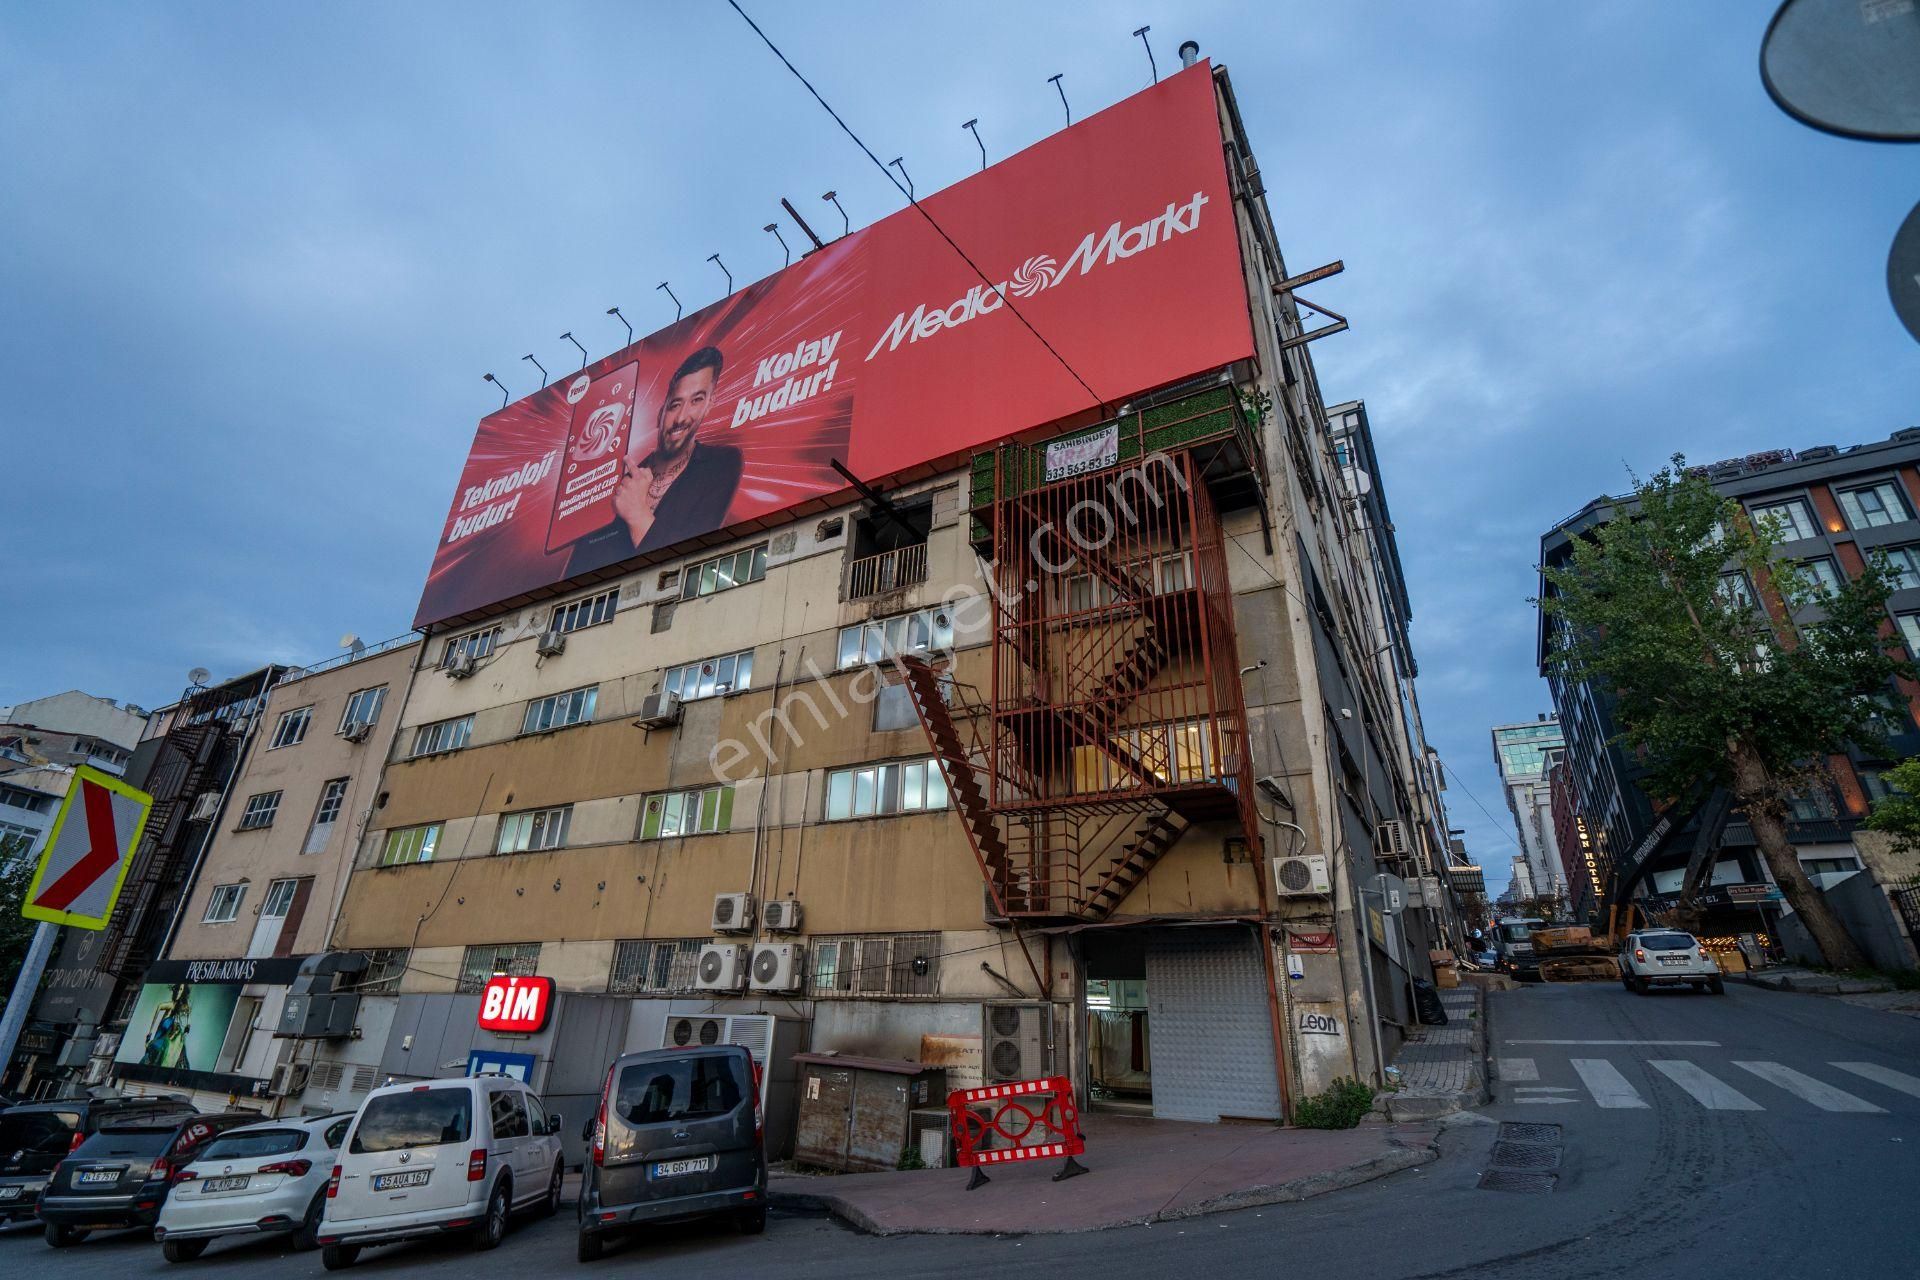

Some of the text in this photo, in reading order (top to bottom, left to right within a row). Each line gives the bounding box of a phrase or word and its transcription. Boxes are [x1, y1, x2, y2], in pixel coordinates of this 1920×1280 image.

[864, 191, 1209, 362] Media Markt
[752, 329, 843, 388] Kolay
[569, 381, 588, 398] Yeni
[730, 358, 840, 429] budur!
[459, 448, 557, 512] Teknoloji
[1046, 466, 1065, 480] 533
[1067, 461, 1086, 475] 563
[447, 491, 522, 543] budur!
[1584, 852, 1602, 893] HOTEL
[482, 977, 540, 1021] BİM
[1299, 1014, 1338, 1033] Leon
[380, 1171, 428, 1187] 35 AUA 167
[658, 1159, 708, 1175] 34 GGY 717
